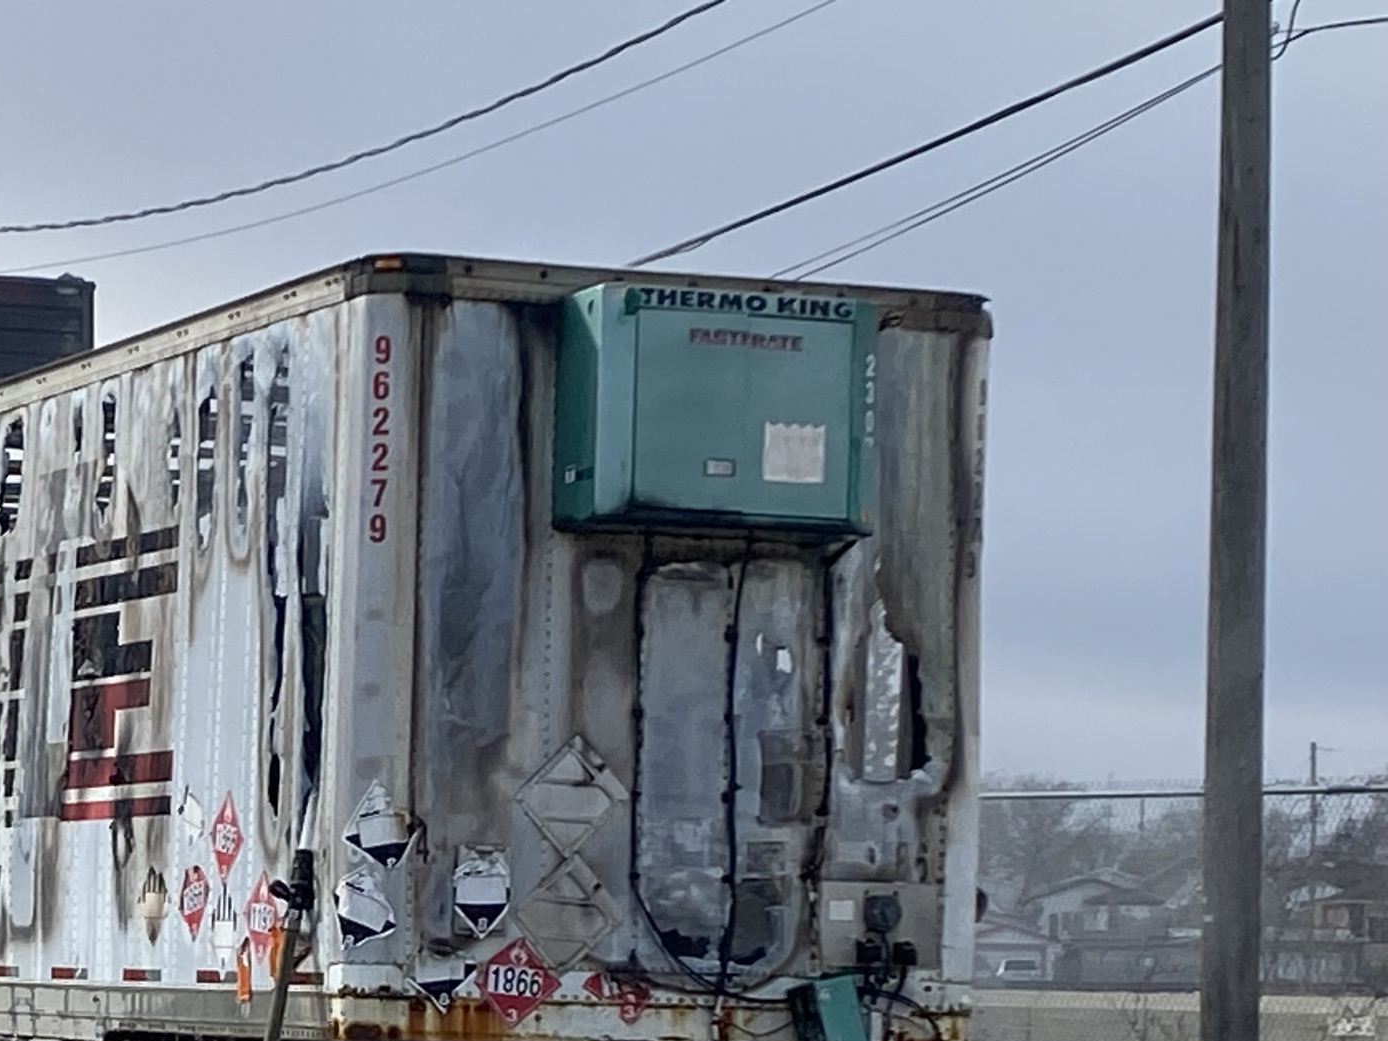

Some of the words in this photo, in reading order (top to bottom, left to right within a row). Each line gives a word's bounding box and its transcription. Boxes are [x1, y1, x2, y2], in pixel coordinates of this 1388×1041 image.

[640, 287, 767, 312] THERMO
[777, 297, 853, 319] KING
[369, 335, 391, 543] 962279
[492, 966, 543, 997] 1866
[506, 1008, 517, 1022] 3
